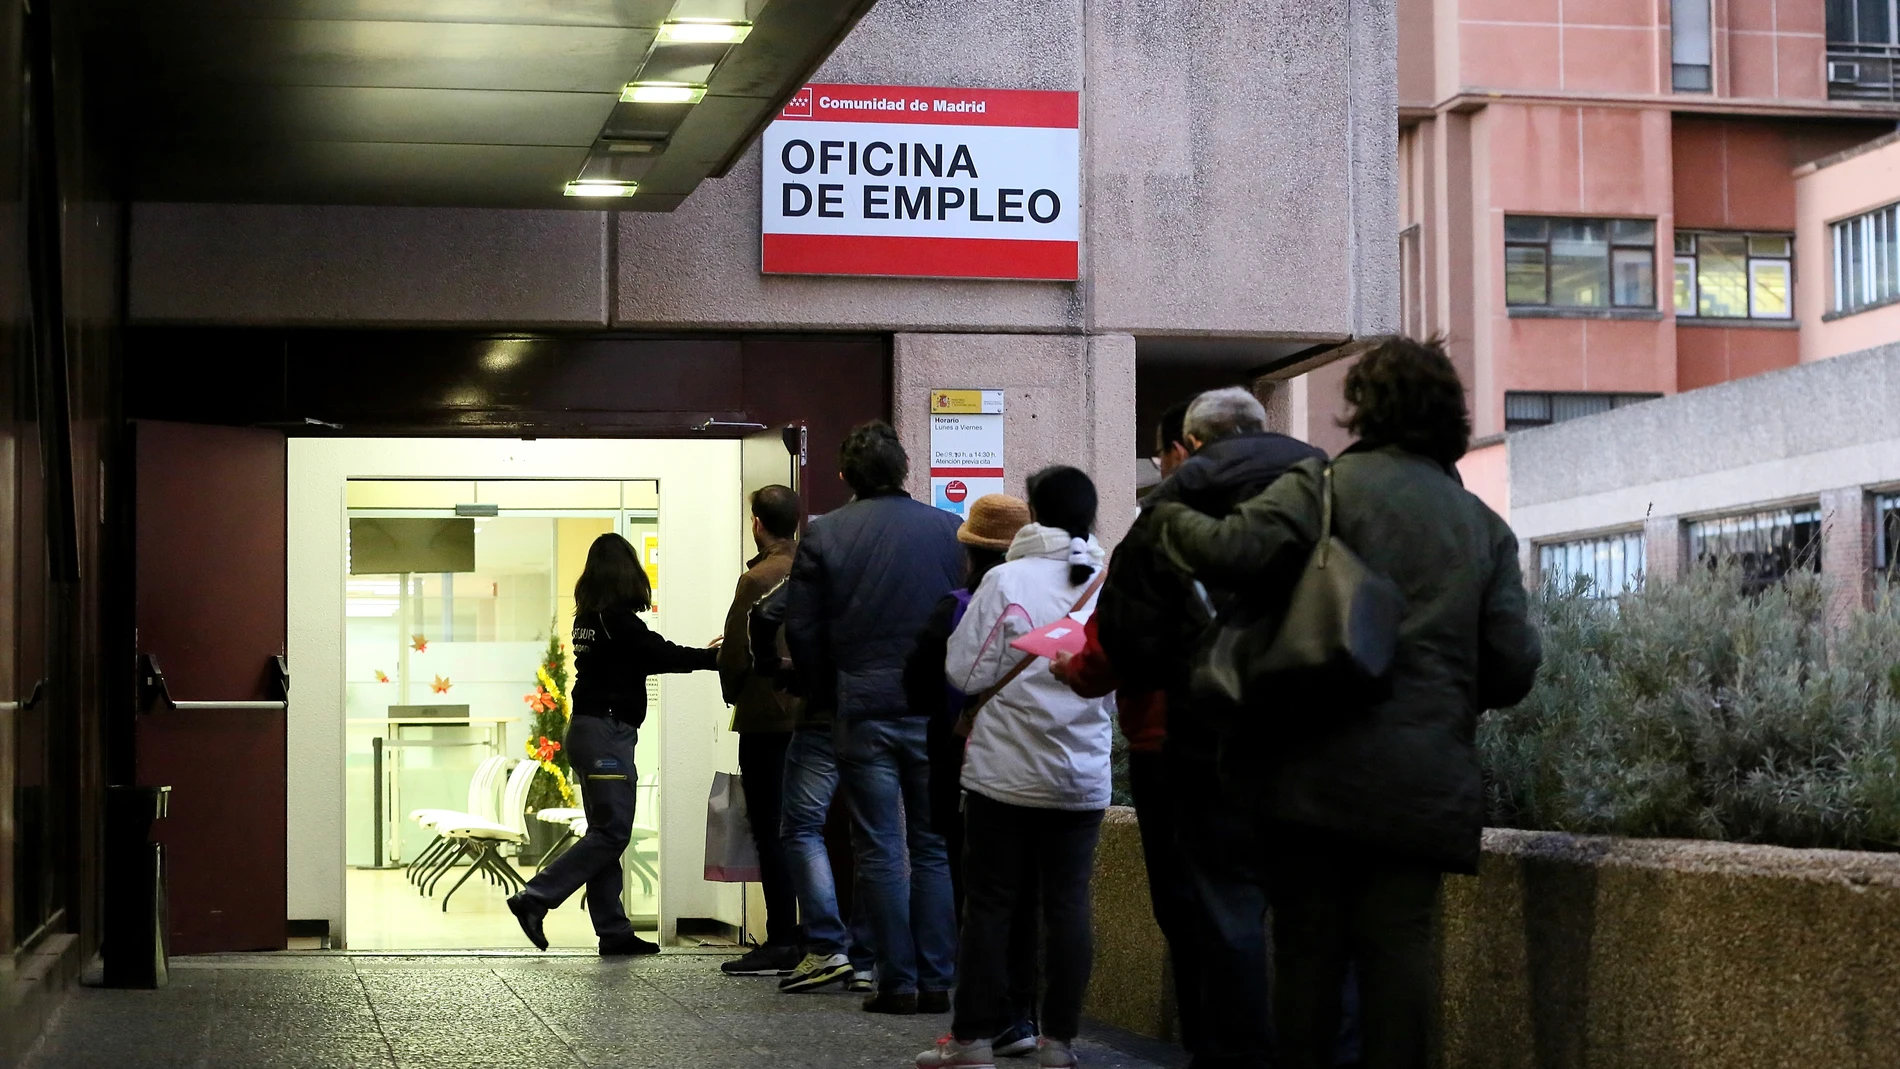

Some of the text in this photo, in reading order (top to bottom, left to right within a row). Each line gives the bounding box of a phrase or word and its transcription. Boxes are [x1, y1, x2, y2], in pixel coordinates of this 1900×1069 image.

[819, 96, 986, 113] Comunidad de Madrid
[781, 138, 978, 178] OFICINA
[782, 182, 1061, 223] DE EMPLEO
[934, 416, 960, 424] Horario
[961, 458, 979, 466] previa
